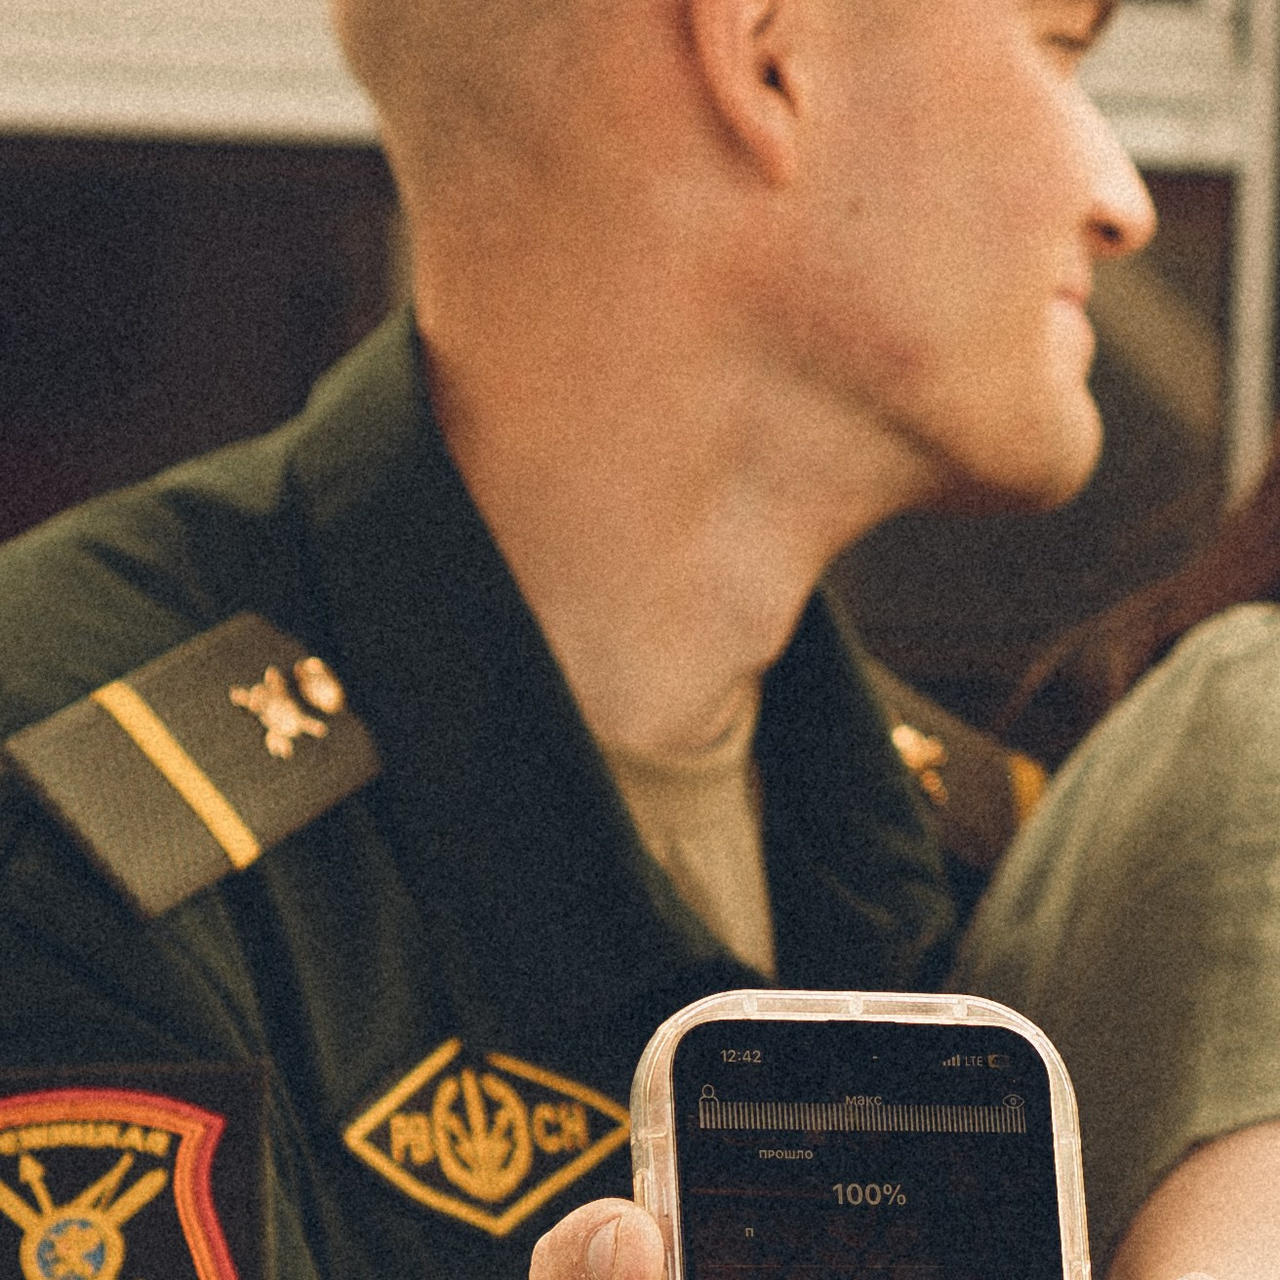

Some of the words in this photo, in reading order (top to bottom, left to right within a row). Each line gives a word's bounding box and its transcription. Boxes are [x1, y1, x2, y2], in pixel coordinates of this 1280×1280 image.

[720, 1050, 762, 1064] 12:42
[965, 1056, 983, 1067] LTE
[845, 1095, 882, 1107] макс
[758, 1149, 814, 1160] прошло
[832, 1182, 907, 1205] 100%
